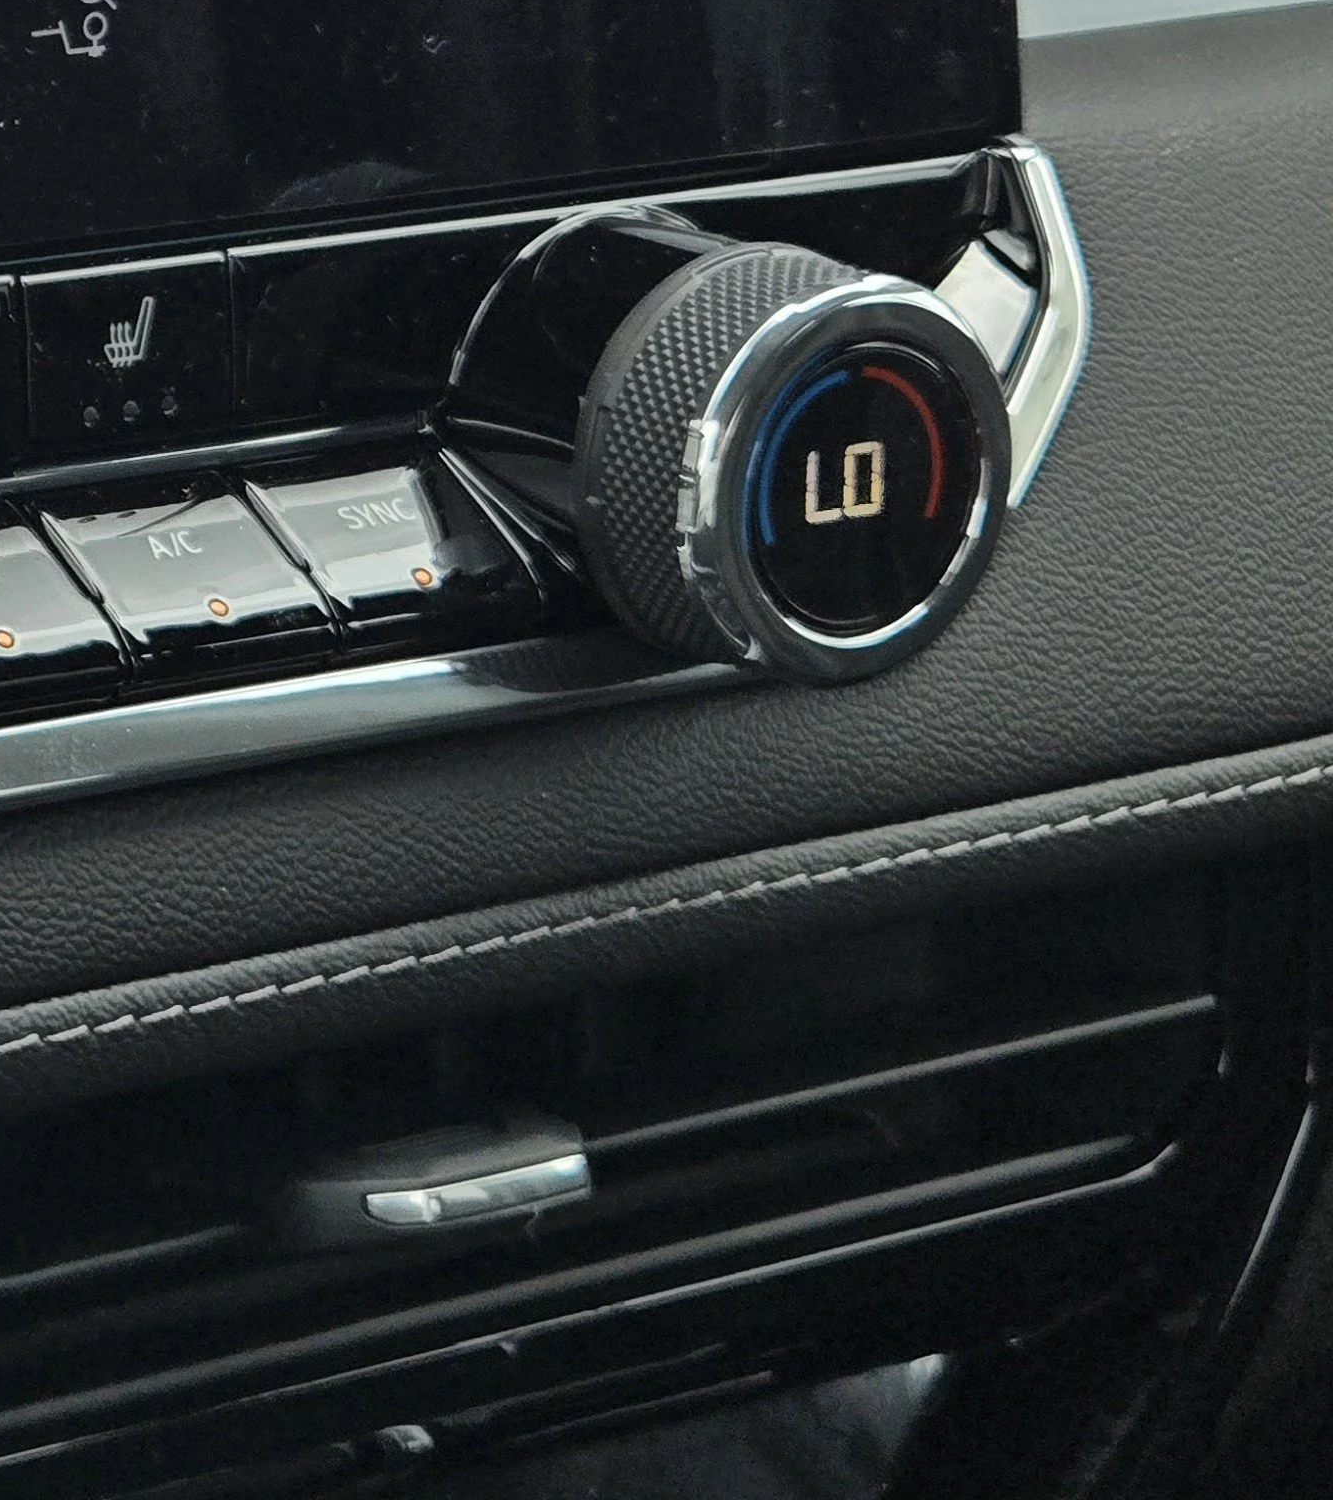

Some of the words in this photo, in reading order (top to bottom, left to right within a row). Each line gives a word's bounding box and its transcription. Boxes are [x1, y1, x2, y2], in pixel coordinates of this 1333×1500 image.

[805, 440, 885, 524] LO
[337, 496, 417, 530] SYNC
[149, 529, 203, 560] A/C
